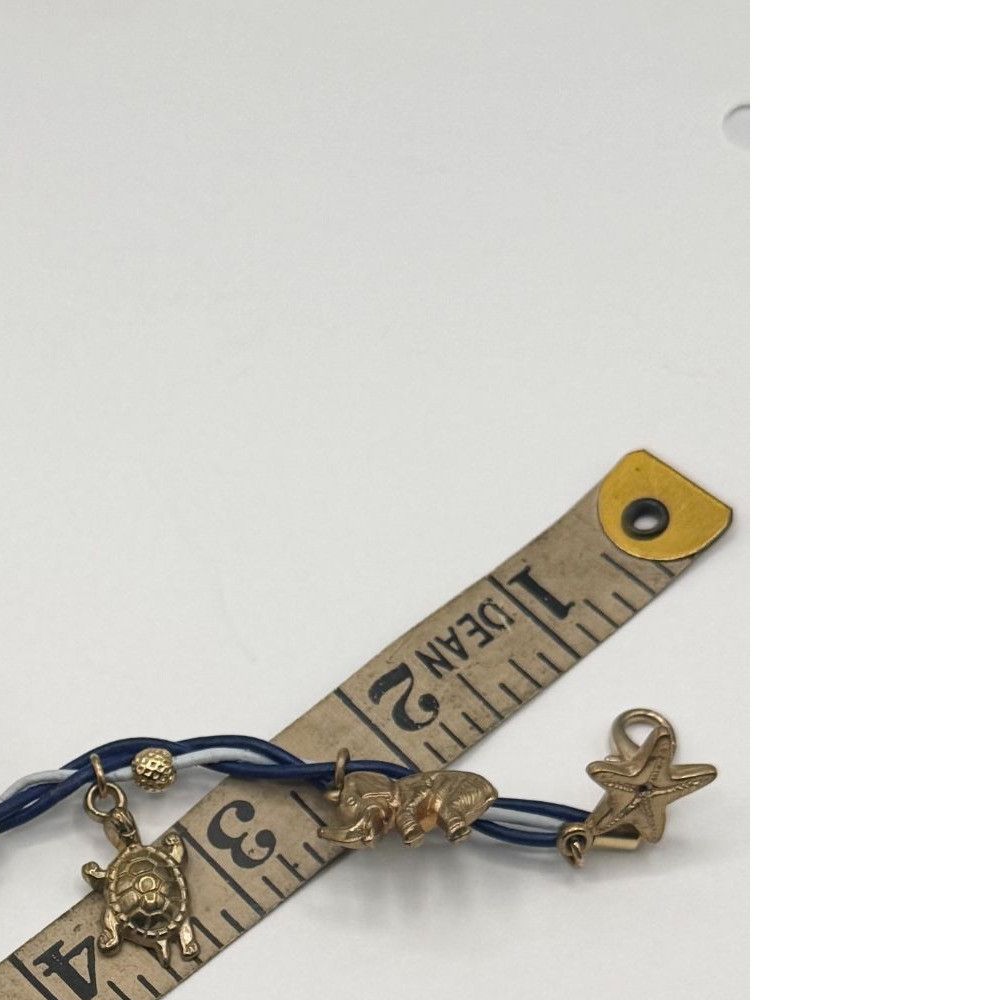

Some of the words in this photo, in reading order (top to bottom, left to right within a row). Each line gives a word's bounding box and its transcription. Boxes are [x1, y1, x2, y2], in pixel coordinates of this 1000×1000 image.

[508, 566, 574, 619] 1
[415, 598, 514, 680] DEAN
[368, 662, 440, 732] 2
[207, 800, 276, 869] 3
